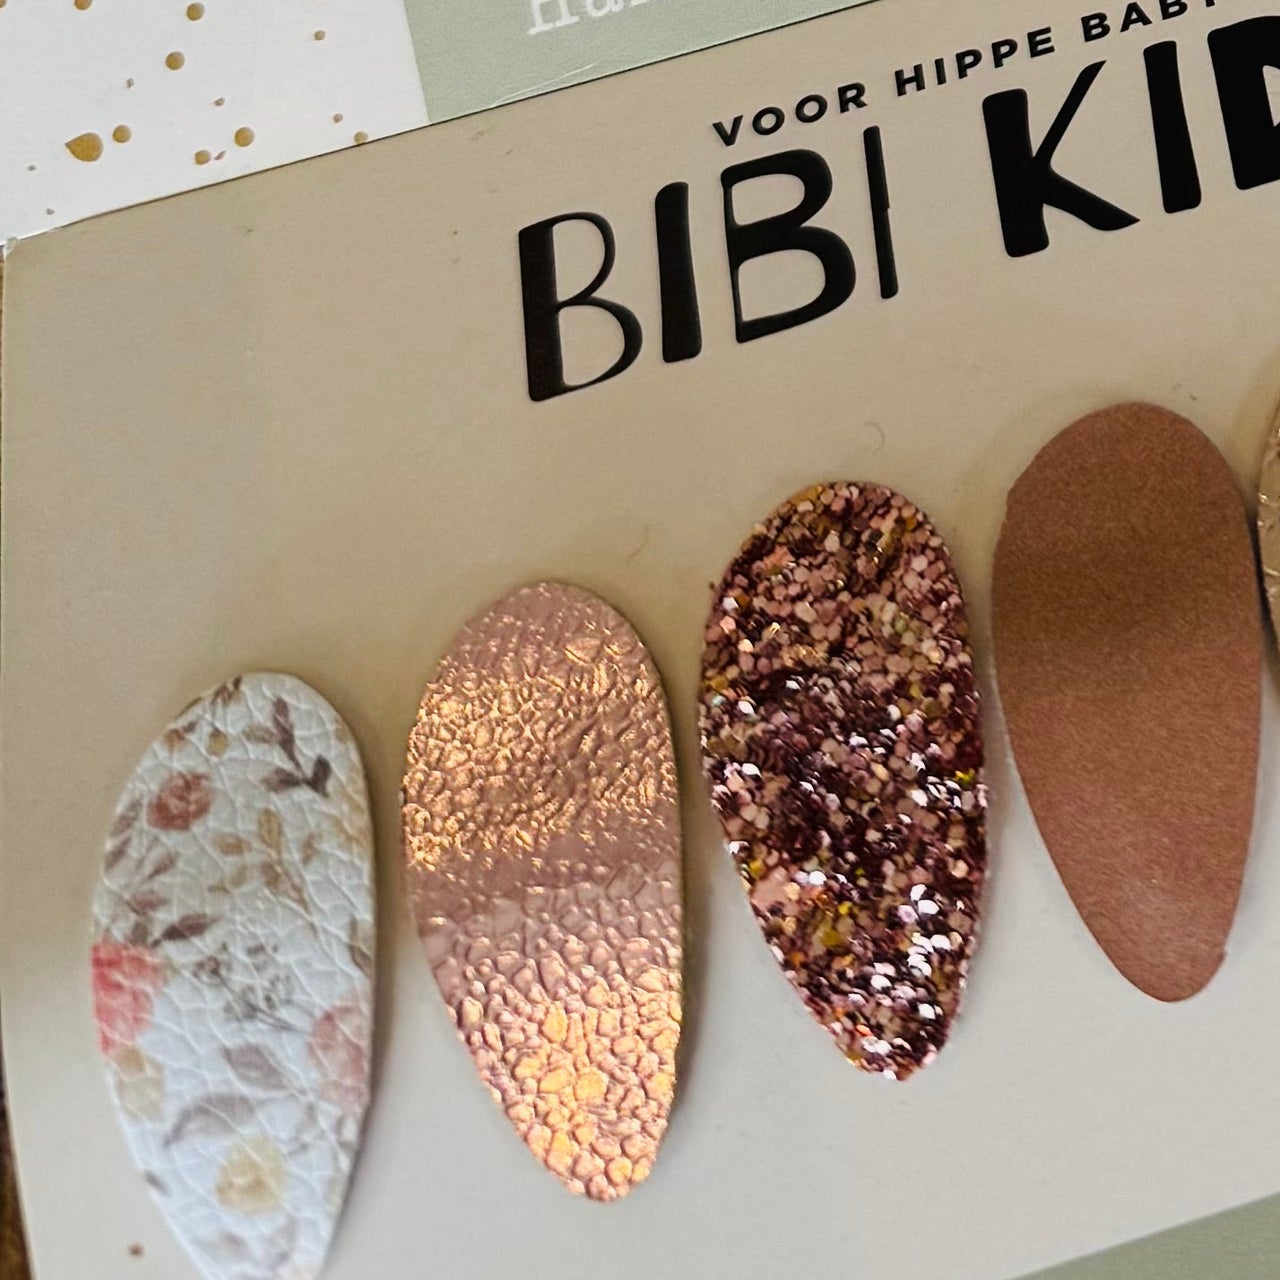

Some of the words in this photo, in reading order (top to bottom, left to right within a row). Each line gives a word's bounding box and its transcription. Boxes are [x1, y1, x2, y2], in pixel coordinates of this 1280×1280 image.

[713, 81, 869, 147] VOOR
[894, 26, 1056, 98] HIPPE
[517, 125, 899, 403] BIBI
